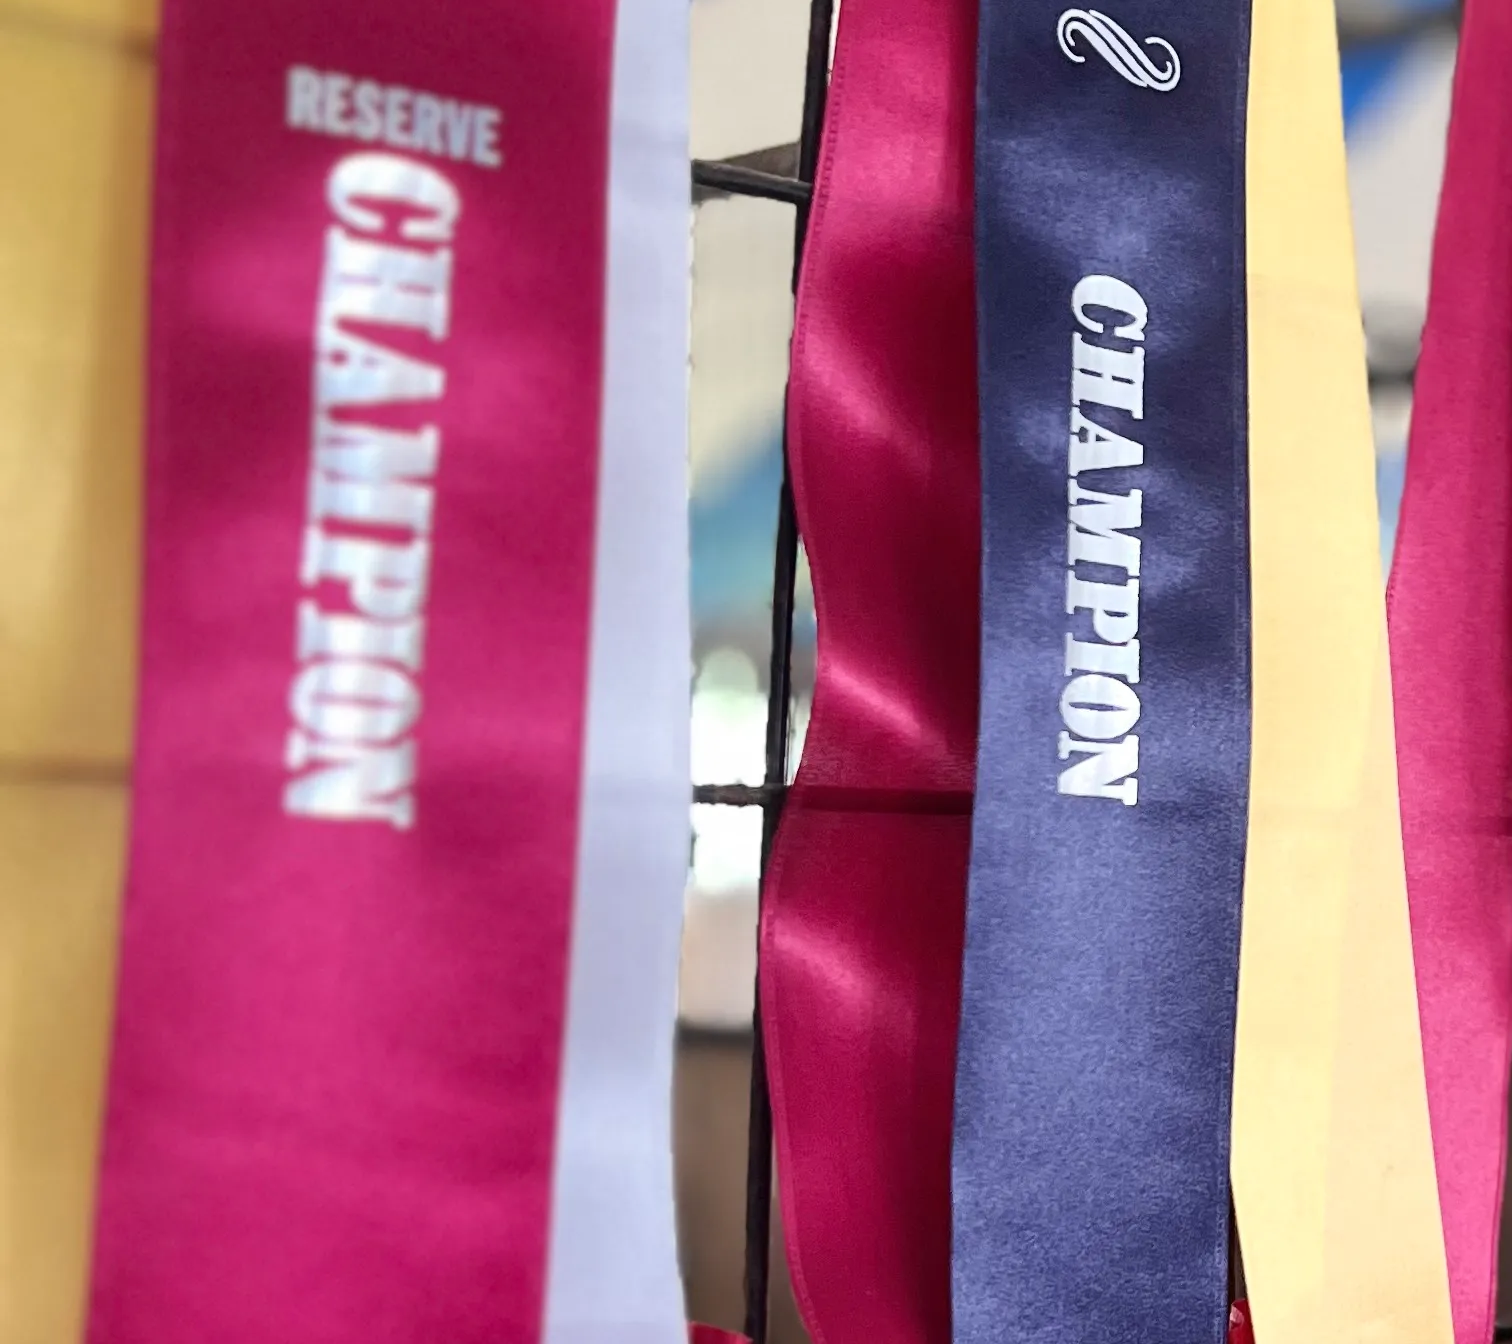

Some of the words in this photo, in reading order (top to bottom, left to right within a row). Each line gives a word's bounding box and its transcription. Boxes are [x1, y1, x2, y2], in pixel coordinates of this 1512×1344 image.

[286, 65, 502, 168] RESERVE
[283, 153, 460, 829] CHAMPION
[1057, 273, 1149, 807] CHAMPION
